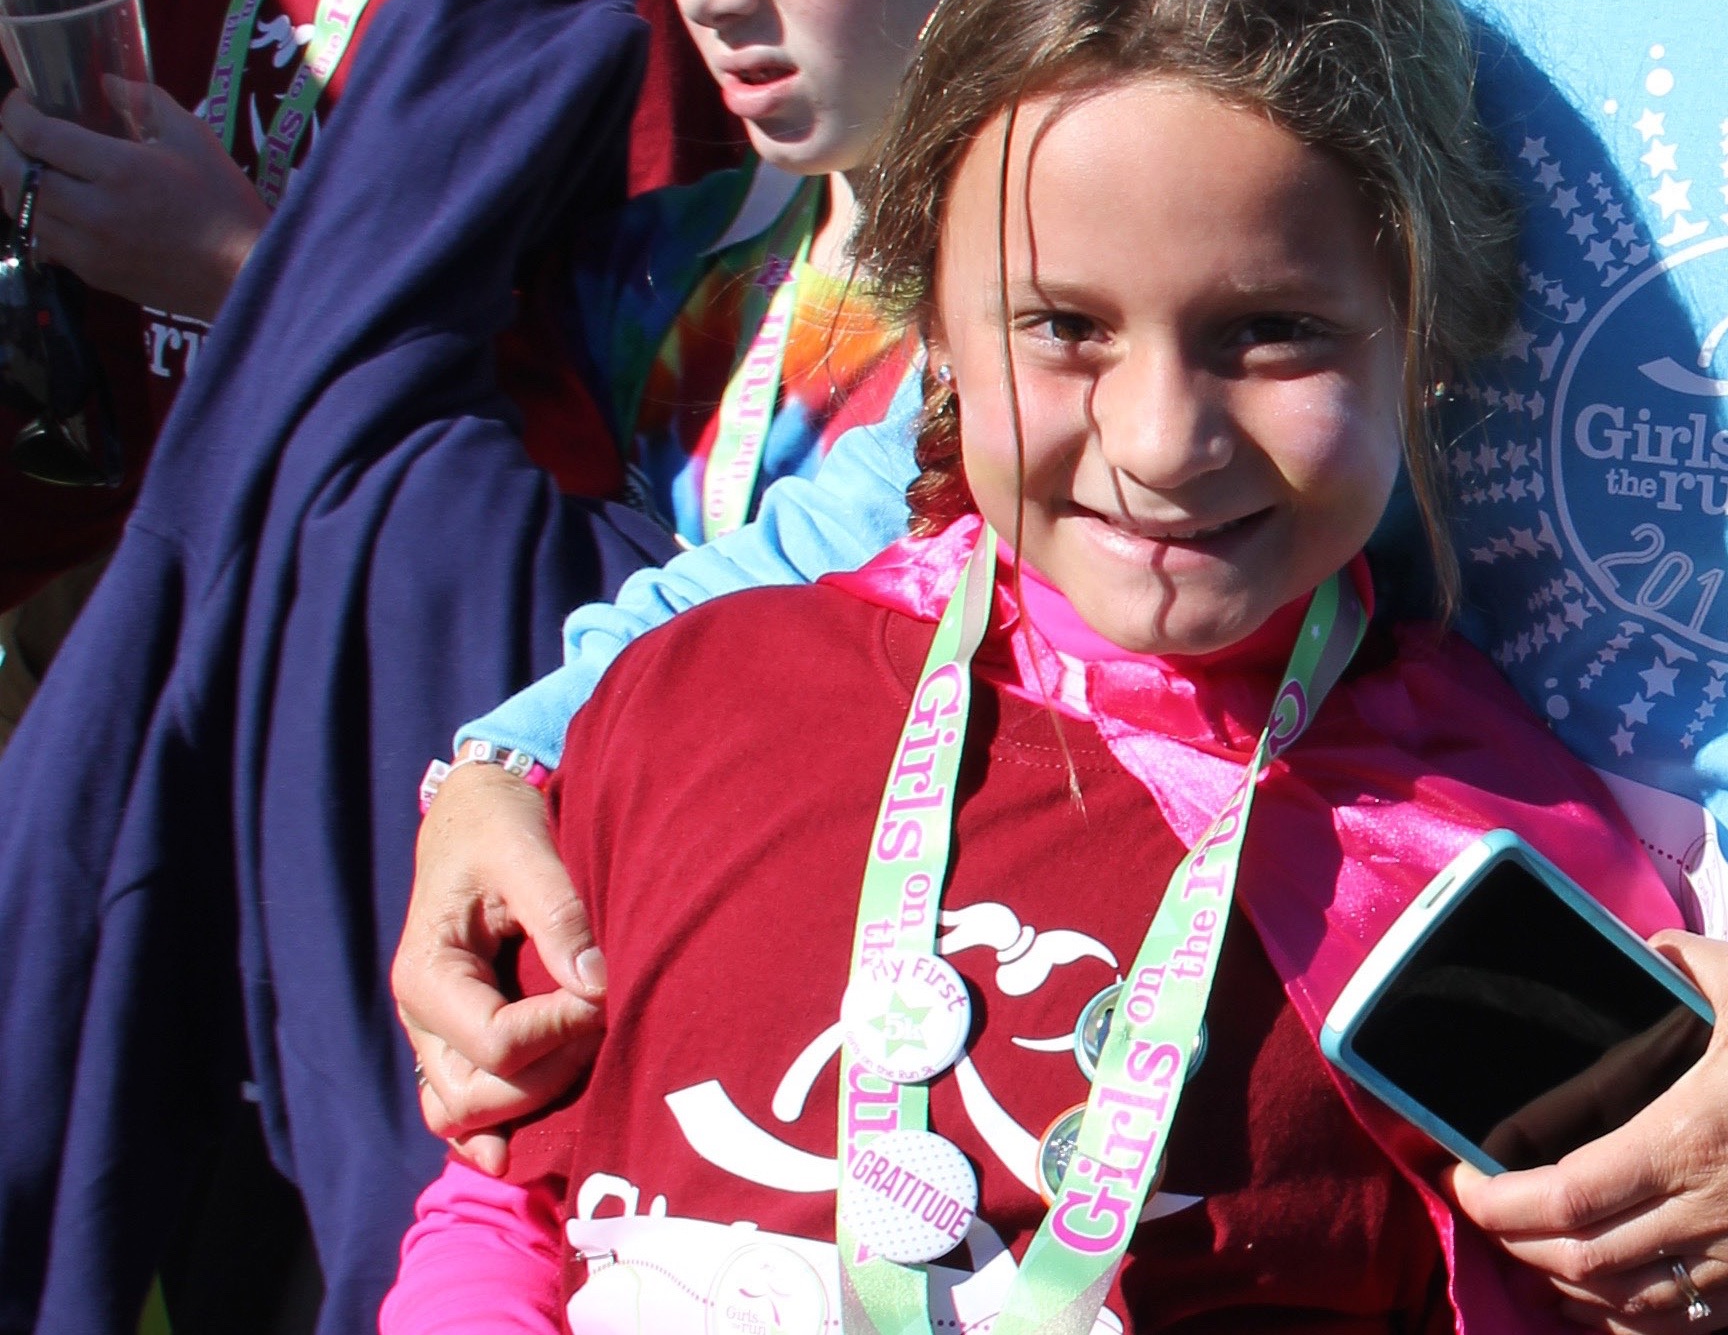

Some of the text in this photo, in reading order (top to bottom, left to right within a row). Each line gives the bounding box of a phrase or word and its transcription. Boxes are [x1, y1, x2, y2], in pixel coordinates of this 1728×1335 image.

[256, 109, 304, 212] irls
[739, 314, 786, 426] run
[1605, 468, 1658, 499] the
[875, 662, 962, 861] Girls
[900, 872, 931, 931] on
[911, 956, 968, 1012] First
[1051, 1040, 1182, 1253] Girls
[1126, 964, 1166, 1023] on
[1170, 909, 1218, 979] the
[852, 1149, 976, 1241] GRATITUDE
